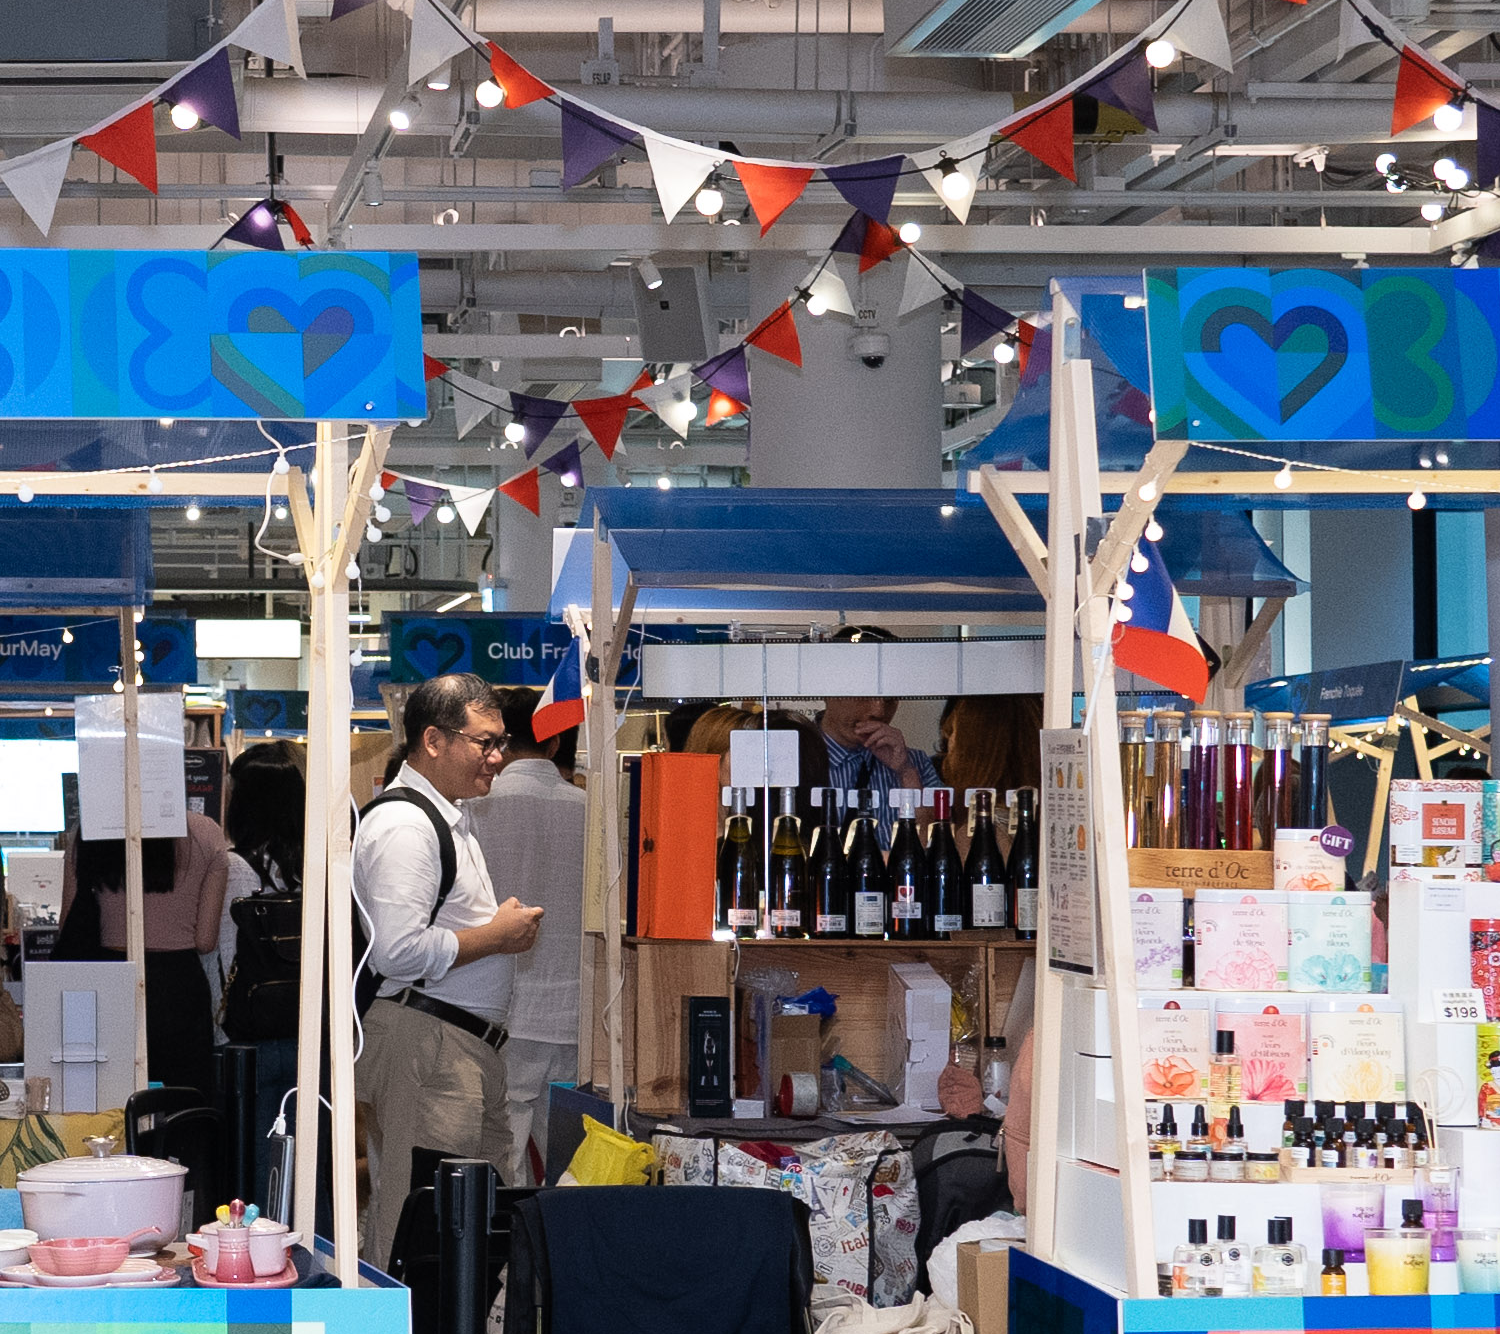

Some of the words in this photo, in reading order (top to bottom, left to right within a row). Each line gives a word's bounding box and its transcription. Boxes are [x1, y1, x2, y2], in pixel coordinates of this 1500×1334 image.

[857, 309, 876, 320] CCTV
[487, 641, 535, 661] Club
[1320, 833, 1353, 852] GIFT
[1165, 861, 1204, 879] terre
[1443, 1005, 1479, 1019] $198
